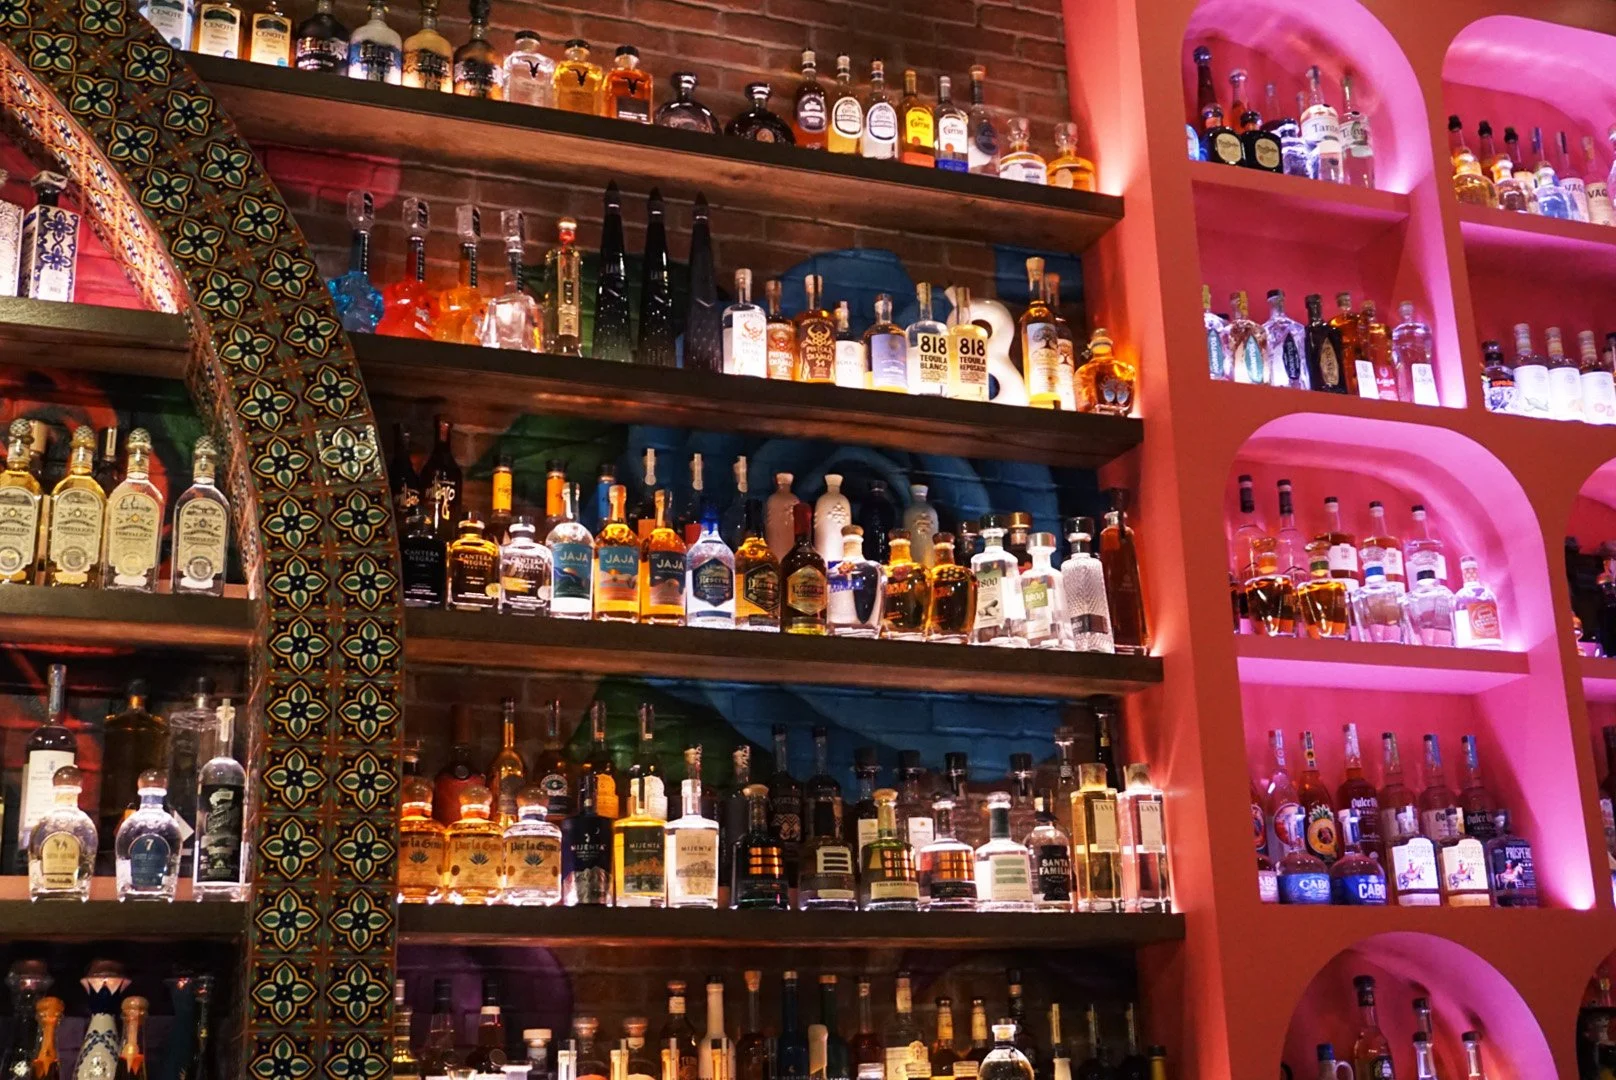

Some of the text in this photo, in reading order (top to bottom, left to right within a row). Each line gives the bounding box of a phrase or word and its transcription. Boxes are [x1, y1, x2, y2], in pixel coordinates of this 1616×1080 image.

[920, 335, 947, 355] 818
[959, 337, 986, 356] 818
[920, 354, 947, 364] TEQUILA
[959, 356, 986, 365] TEQUILA
[1210, 336, 1220, 375] HORNITOS
[920, 362, 948, 372] BLANCO
[404, 549, 440, 557] CANTERA
[459, 553, 493, 561] CANTERA
[559, 551, 588, 562] JAJA
[605, 553, 635, 564] JAJA
[511, 556, 543, 565] CANTERA
[656, 559, 684, 571] JAJA
[145, 838, 155, 851] 7
[571, 843, 606, 851] MIJENTA
[1042, 858, 1069, 867] SANTA
[1258, 876, 1277, 887] ABO
[1359, 883, 1386, 900] CABO
